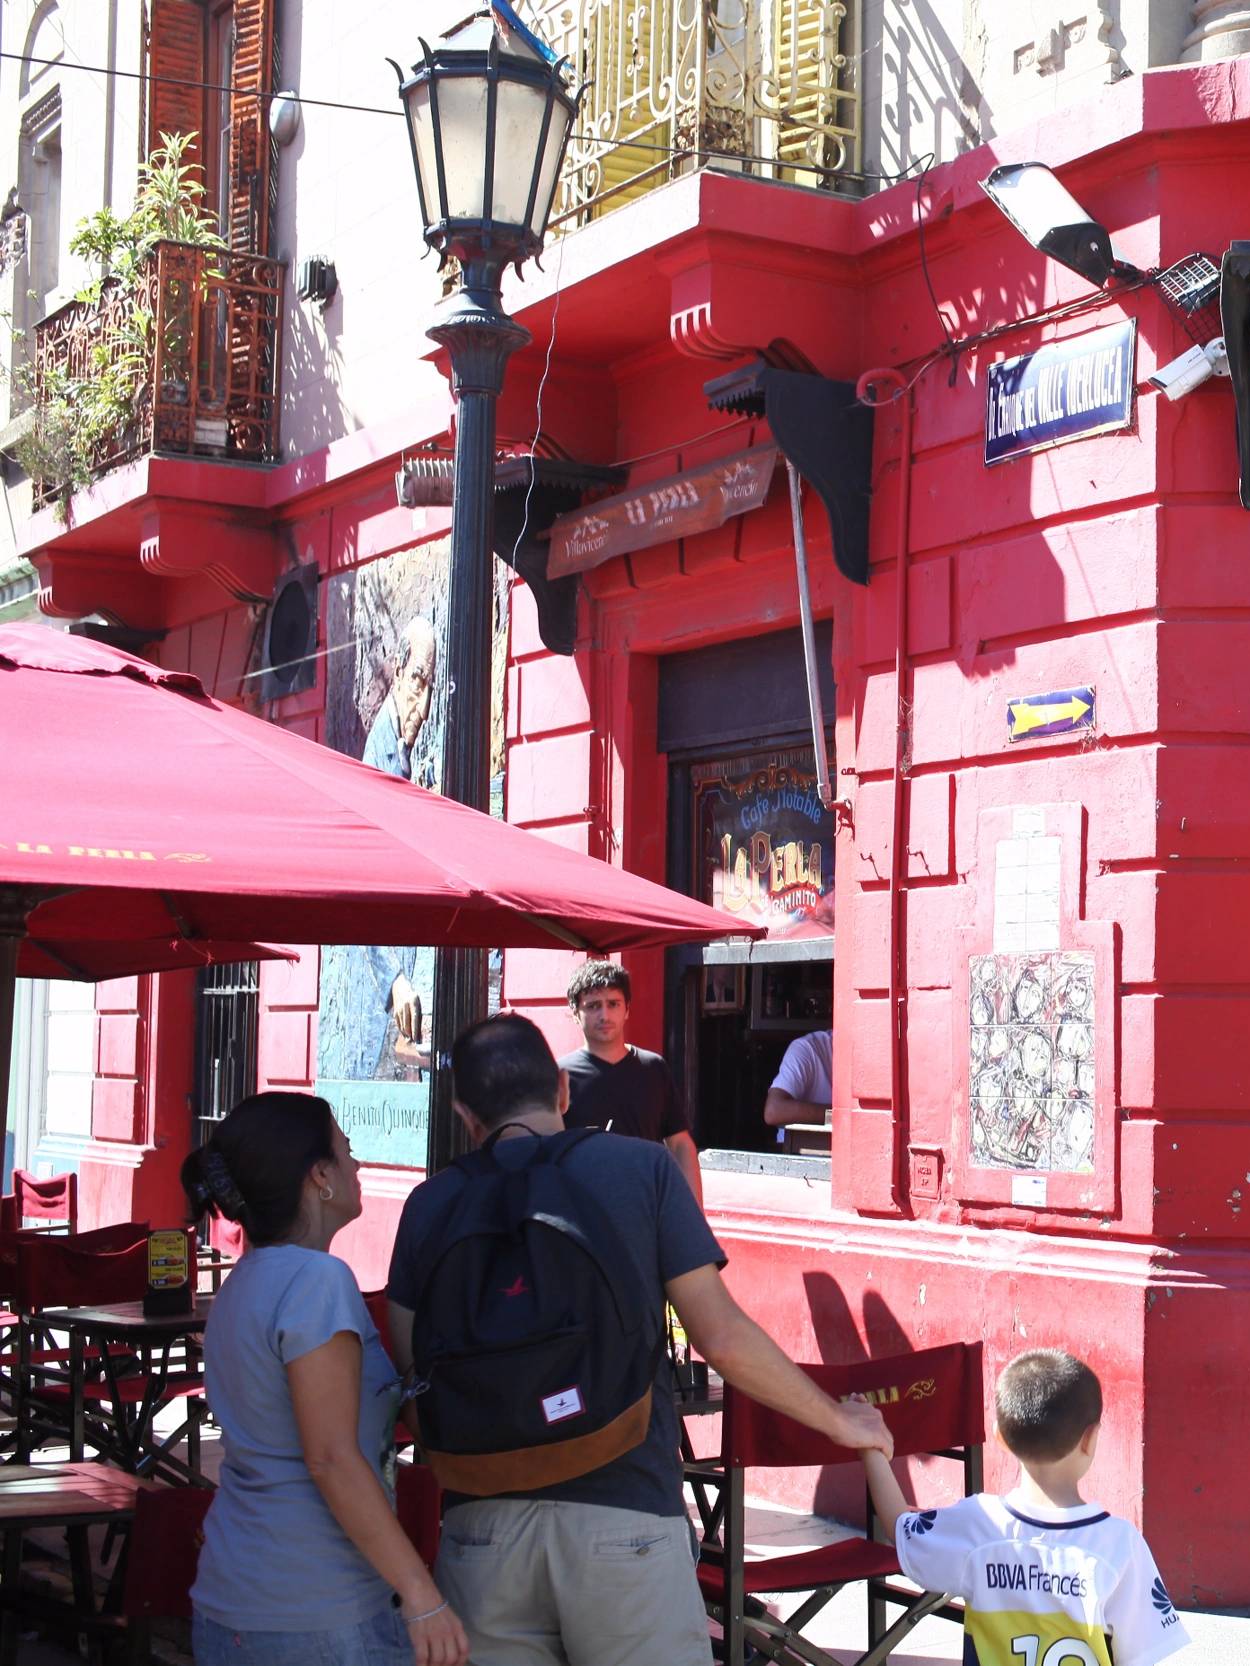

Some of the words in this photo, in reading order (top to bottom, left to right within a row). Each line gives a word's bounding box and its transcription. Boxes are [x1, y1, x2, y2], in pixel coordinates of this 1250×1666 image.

[1066, 346, 1123, 417] IBERLUCEA
[986, 1563, 1028, 1592] BBVA
[1027, 1564, 1089, 1599] Francés
